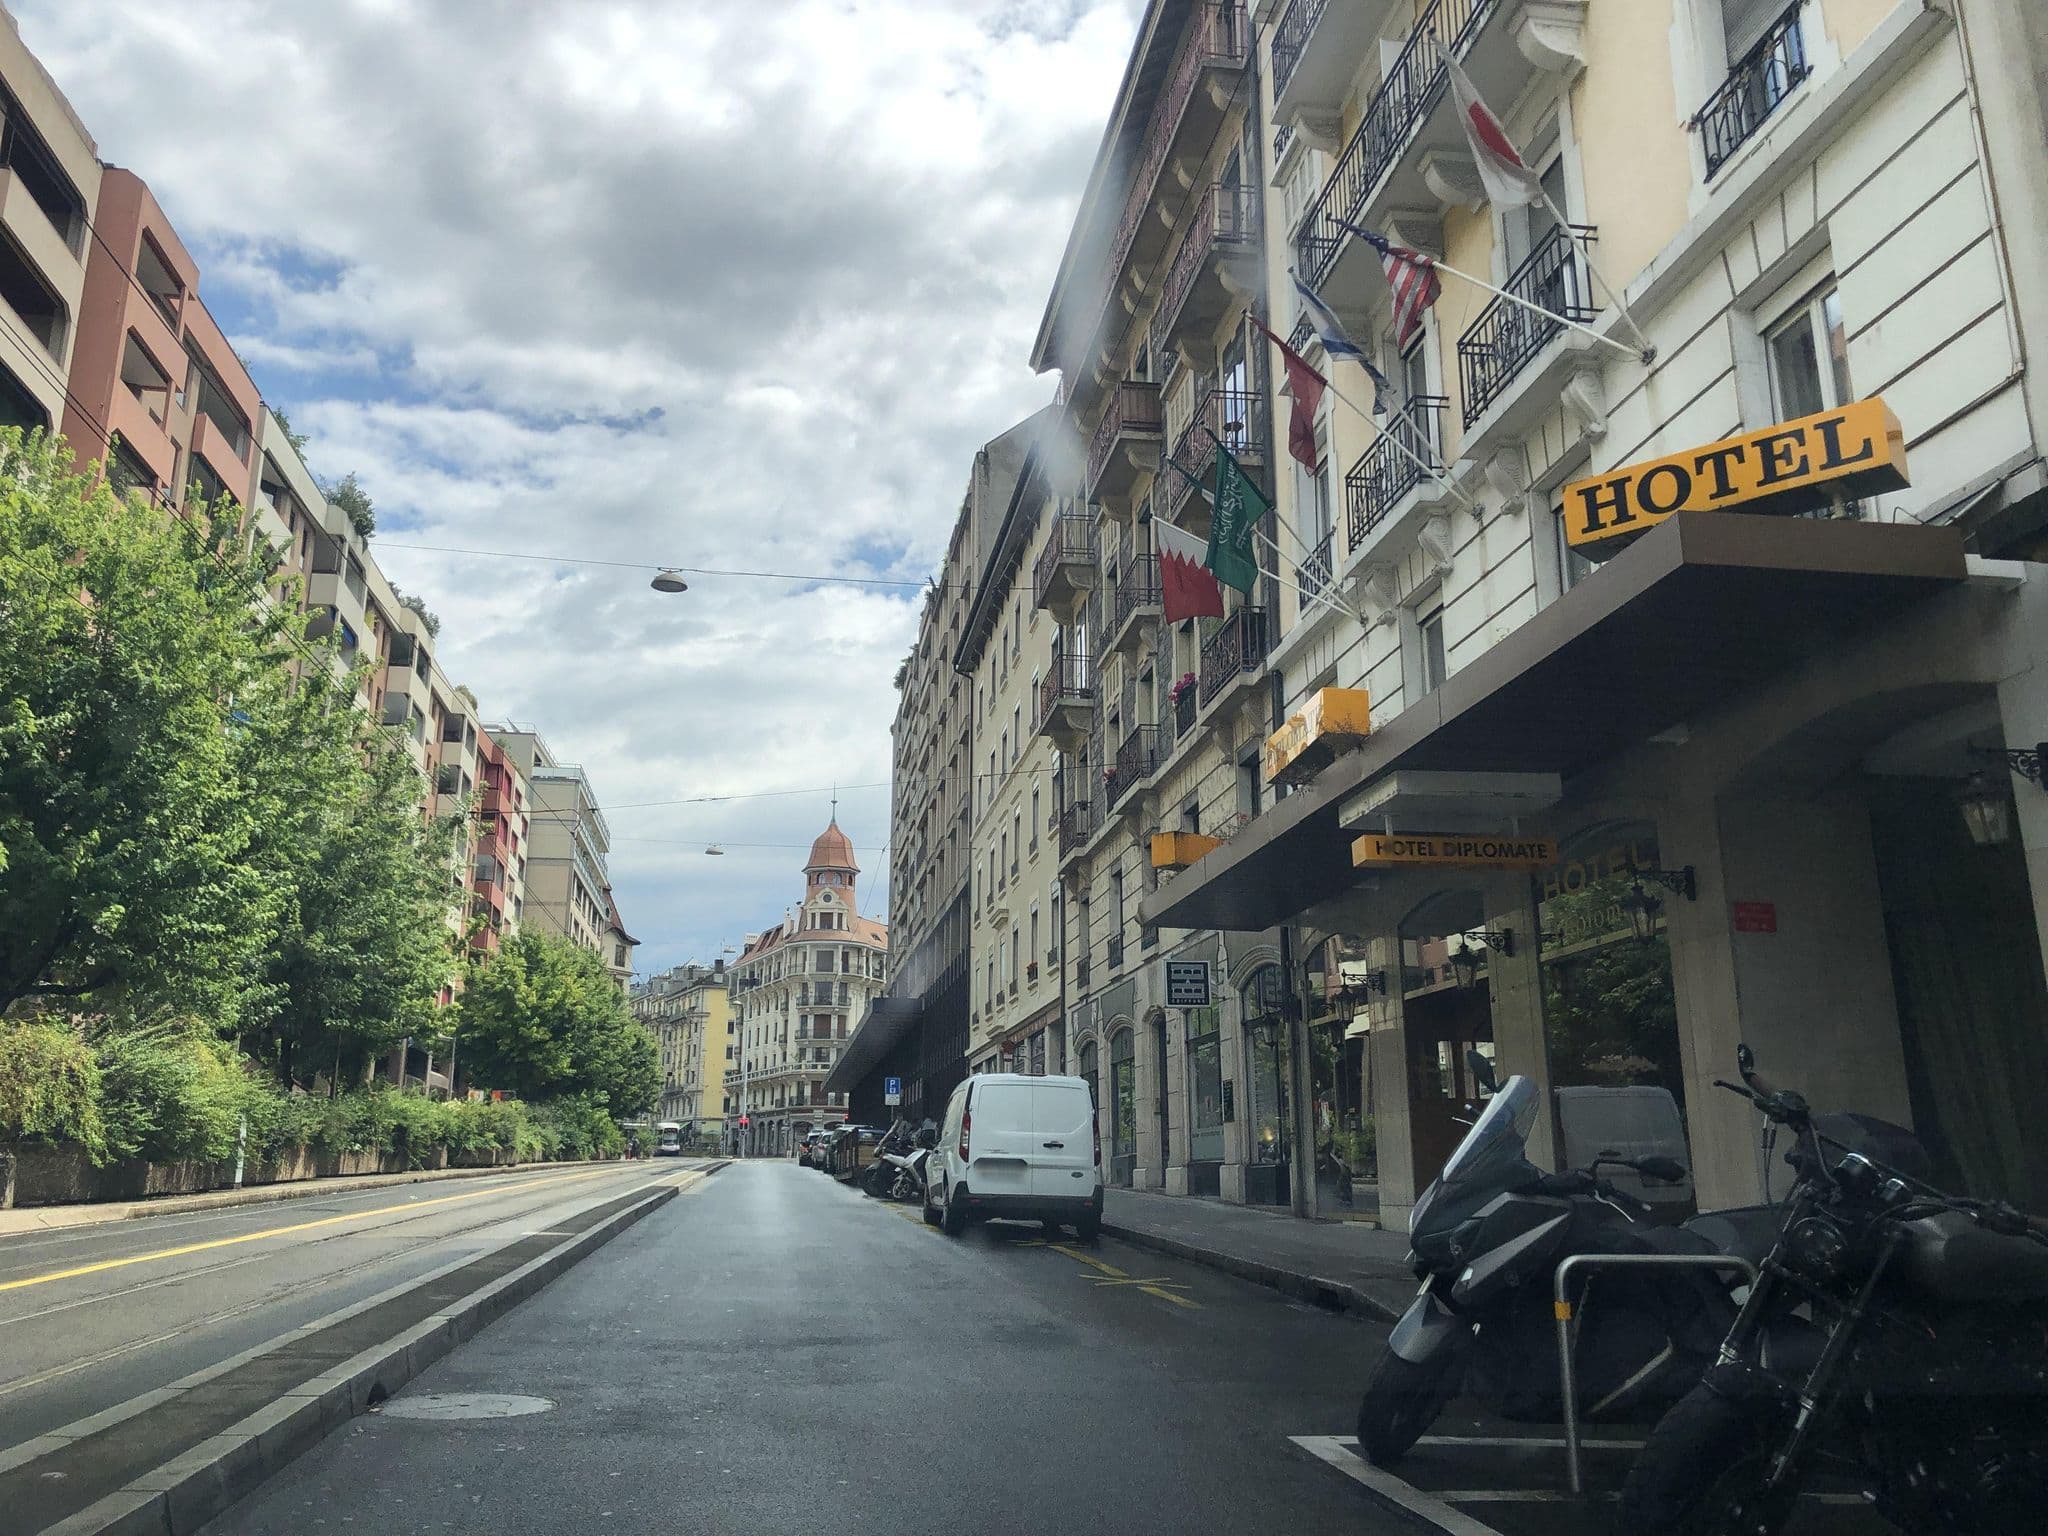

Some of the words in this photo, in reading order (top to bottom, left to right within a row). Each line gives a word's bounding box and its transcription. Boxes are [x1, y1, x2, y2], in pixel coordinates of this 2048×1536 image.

[1577, 416, 1875, 535] HOTEL
[1376, 840, 1437, 857] HOTEL
[1443, 842, 1548, 859] DIPLOMATE
[889, 1079, 896, 1088] P
